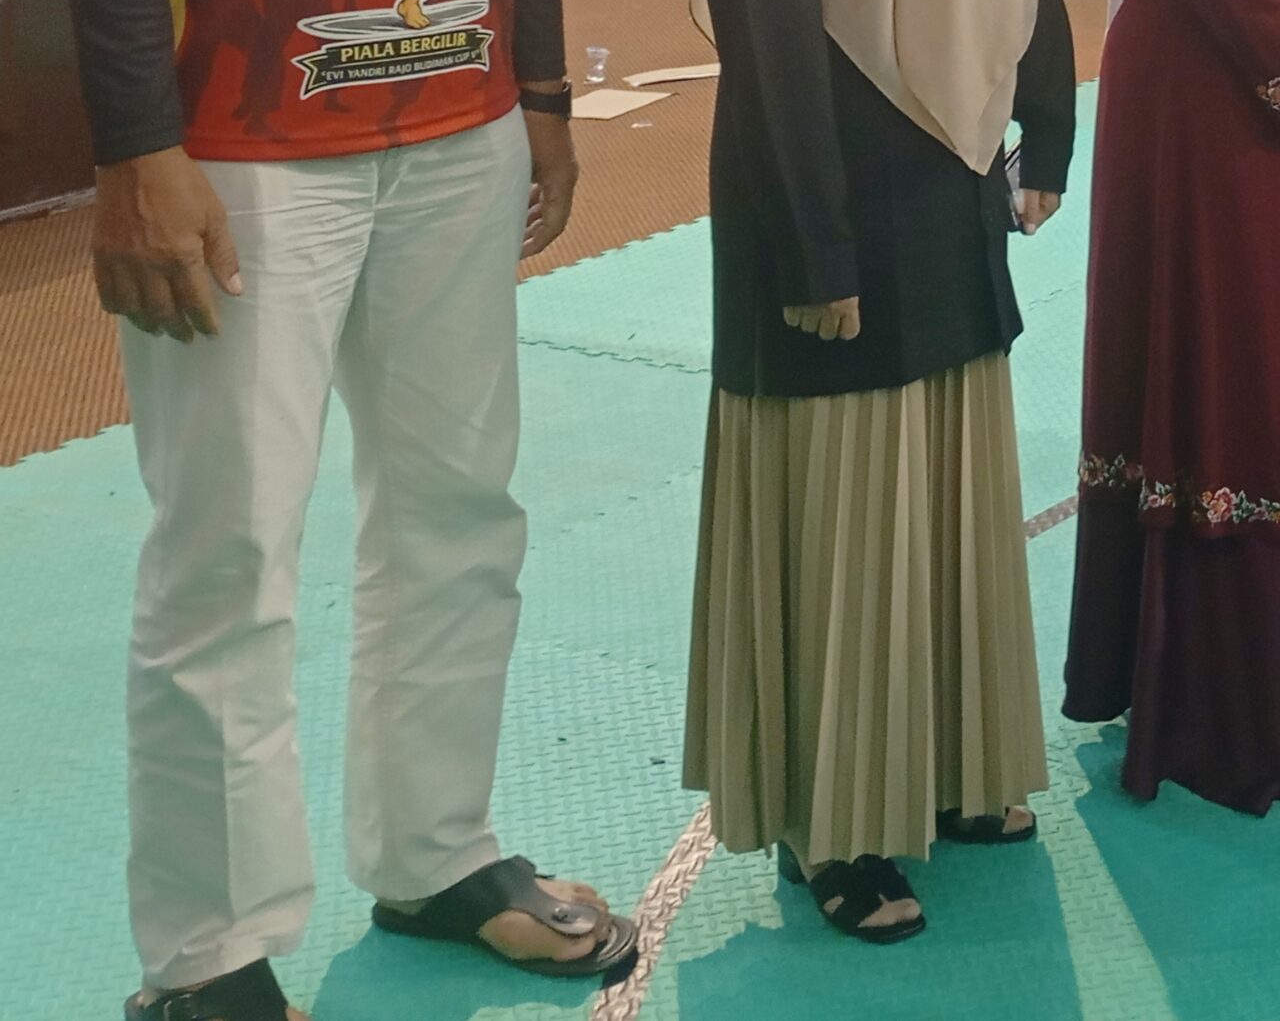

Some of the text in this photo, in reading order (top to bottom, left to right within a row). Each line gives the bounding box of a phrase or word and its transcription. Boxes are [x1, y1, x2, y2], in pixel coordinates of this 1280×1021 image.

[340, 31, 467, 62] PIALA BERGILIR
[347, 66, 386, 80] YANDRI
[388, 62, 412, 76] RAJO
[414, 56, 452, 71] BUDIMAN
